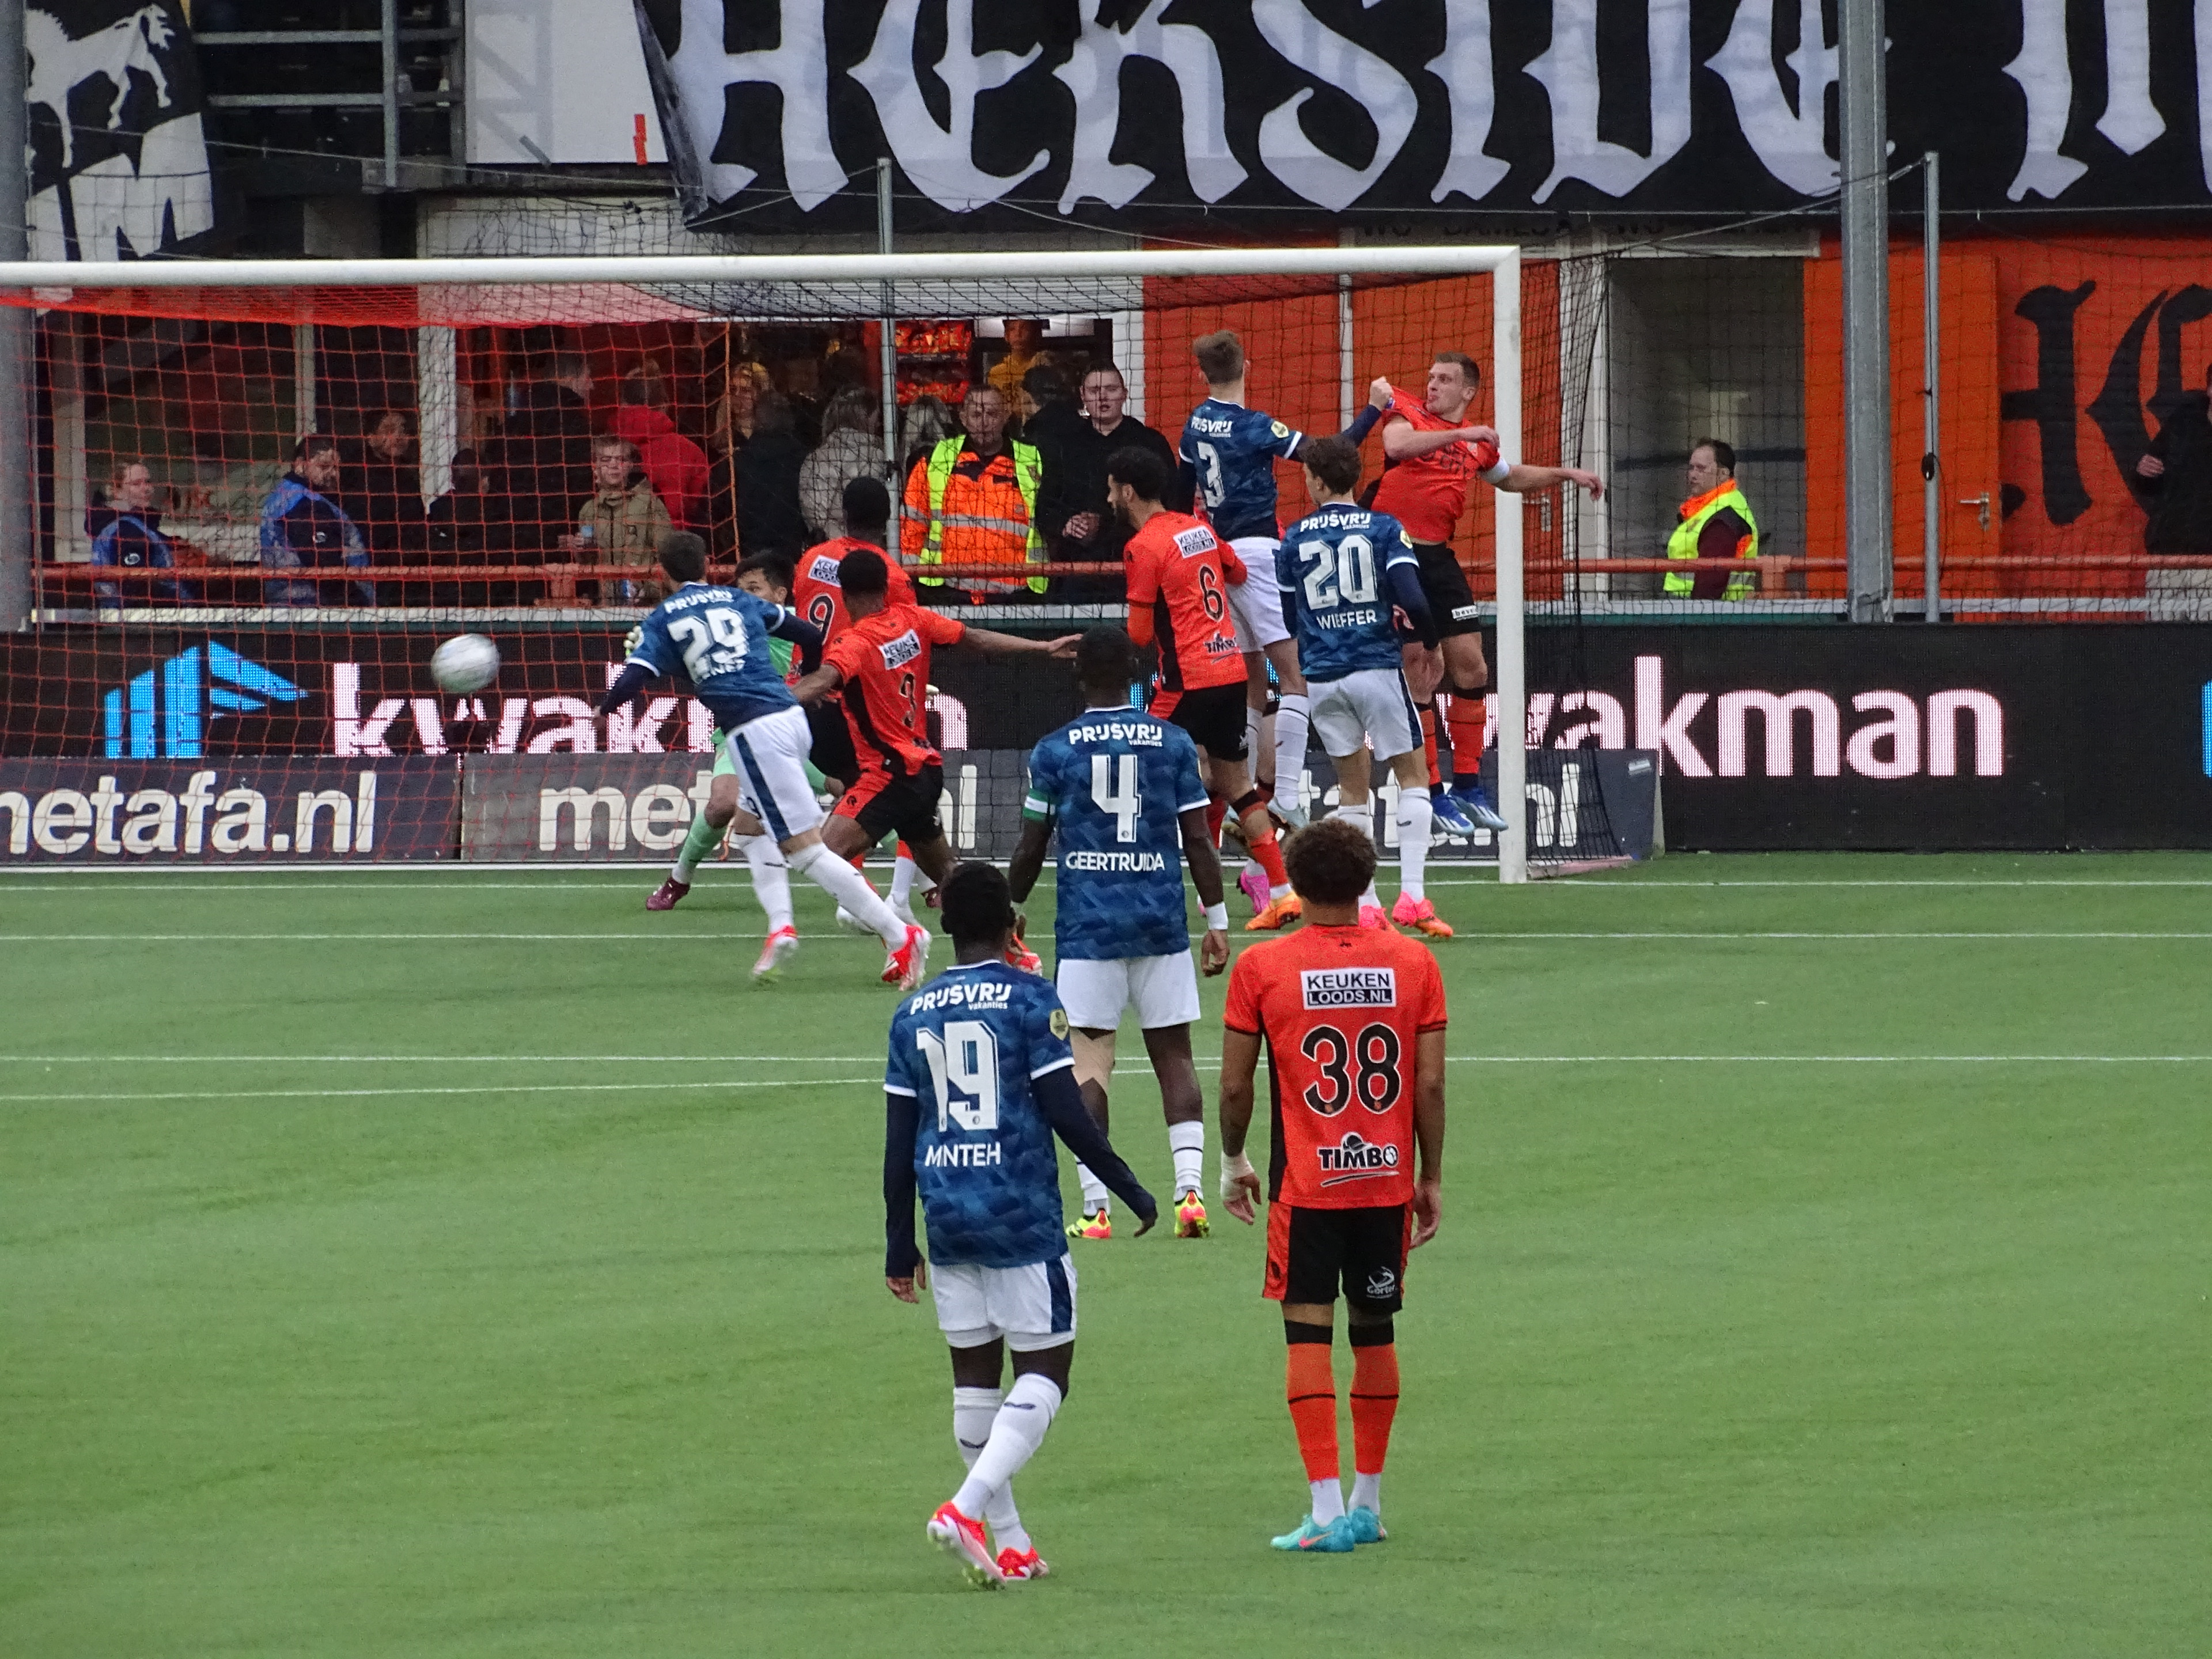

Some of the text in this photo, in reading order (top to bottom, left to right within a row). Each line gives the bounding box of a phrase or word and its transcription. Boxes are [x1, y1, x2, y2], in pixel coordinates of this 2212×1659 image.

[1197, 441, 1225, 507] 3
[1300, 513, 1370, 532] PRIJSVRIJ
[1199, 564, 1224, 622] 6
[1299, 534, 1378, 611] 20
[808, 592, 835, 645] 9
[667, 607, 750, 685] 29
[333, 662, 969, 757] kwakn
[1069, 724, 1162, 745] PRIJSVRIJ
[1092, 754, 1141, 843] 4
[1066, 851, 1165, 872] GEERTRUIDA
[910, 982, 1012, 1015] PRIJSVRIJ
[968, 1001, 1007, 1010] vakanties
[1307, 973, 1389, 990] KEUKEN
[1308, 990, 1392, 1005] LOODS.NL
[916, 1020, 999, 1132] 19
[1301, 1021, 1402, 1117] 38
[1317, 1146, 1399, 1170] TIMBO
